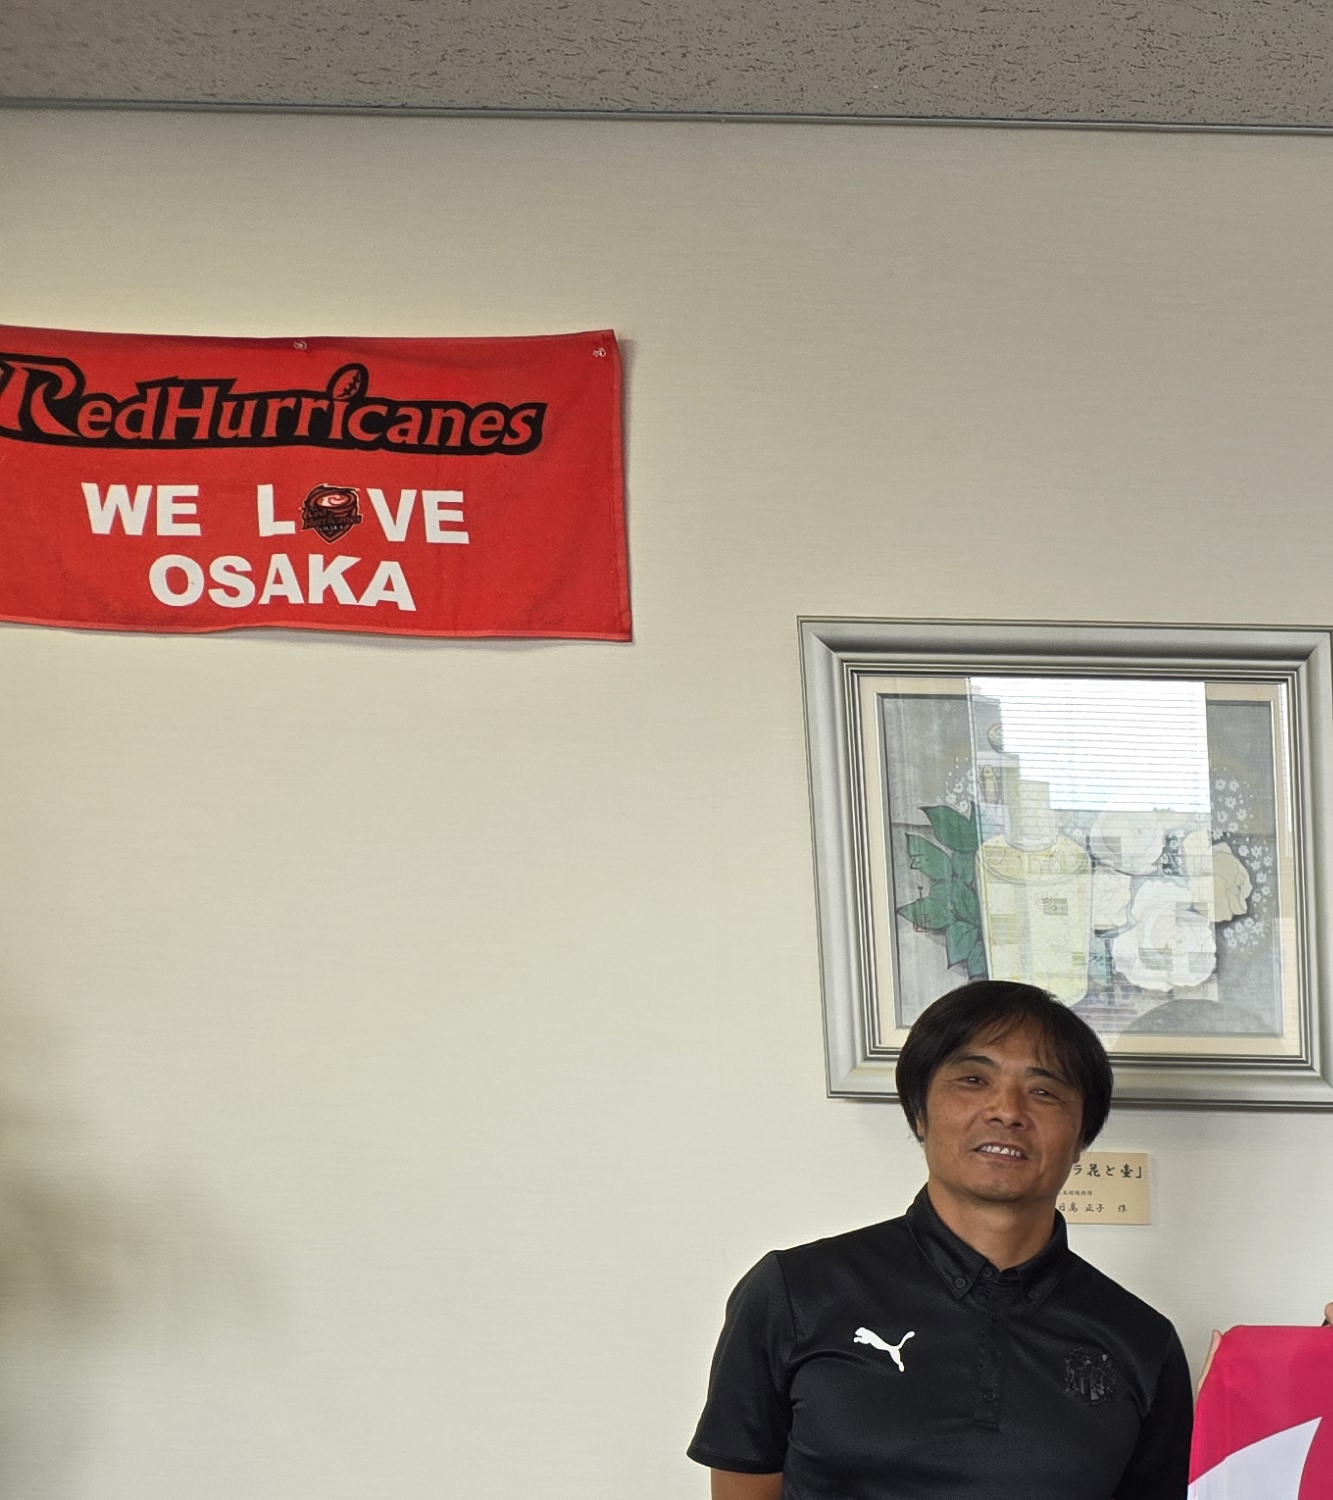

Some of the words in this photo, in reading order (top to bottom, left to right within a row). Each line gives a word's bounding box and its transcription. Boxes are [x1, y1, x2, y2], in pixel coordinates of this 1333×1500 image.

[0, 352, 547, 455] RedHurricanes
[81, 482, 201, 536] WE
[149, 553, 417, 611] OSAKA
